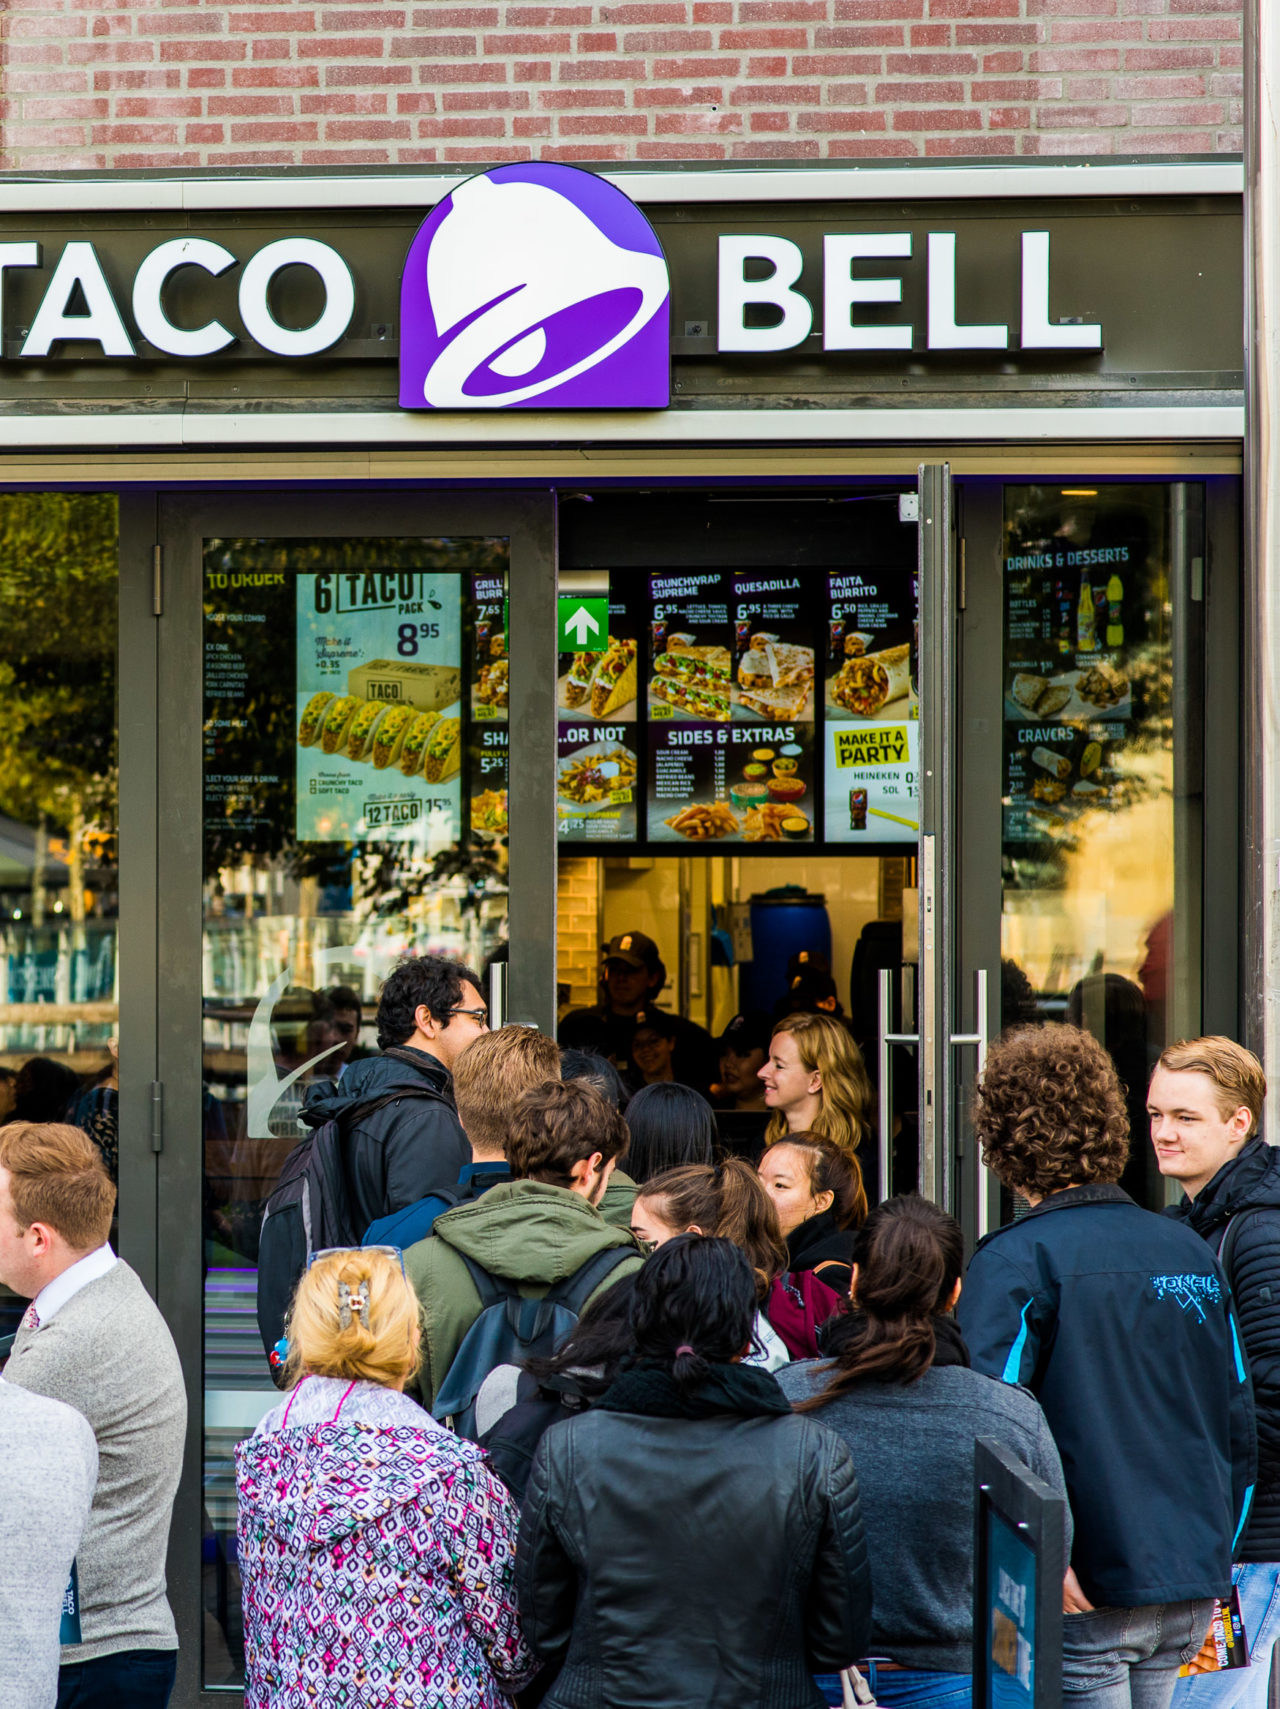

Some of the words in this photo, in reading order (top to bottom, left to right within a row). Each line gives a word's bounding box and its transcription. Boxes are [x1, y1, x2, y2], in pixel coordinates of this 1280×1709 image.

[717, 231, 1104, 354] BELL
[1007, 553, 1053, 571] DRINKS
[1056, 553, 1064, 567] &
[1067, 547, 1129, 566] DESSERTS
[206, 574, 228, 589] TO
[231, 573, 285, 588] ORDER
[475, 579, 504, 590] GRILL
[651, 574, 721, 590] CRUNCHWRAP
[734, 578, 800, 595] QUESADILLA
[829, 576, 863, 588] FAJITA
[315, 573, 332, 614] 6
[345, 573, 414, 606] TACO
[652, 586, 699, 599] SUPREME
[830, 586, 877, 599] BURRITO
[398, 602, 424, 615] PACK
[1009, 600, 1037, 608] BOTTLES
[370, 683, 399, 699] TACO
[593, 726, 626, 741] NOT
[668, 730, 713, 745] SIDES
[716, 729, 728, 744] &
[732, 727, 795, 744] EXTRAS
[839, 732, 877, 747] MAKE
[879, 731, 891, 744] IT
[895, 730, 904, 742] A
[1018, 726, 1074, 743] CRAVERS
[840, 743, 905, 765] PARTY
[853, 771, 900, 780] HEINEKEN
[882, 786, 899, 794] SOL
[368, 807, 381, 824] 12
[383, 803, 419, 821] TACO
[1212, 1607, 1222, 1620] TO
[1213, 1620, 1226, 1643] TACO
[1217, 1642, 1228, 1667] COME
